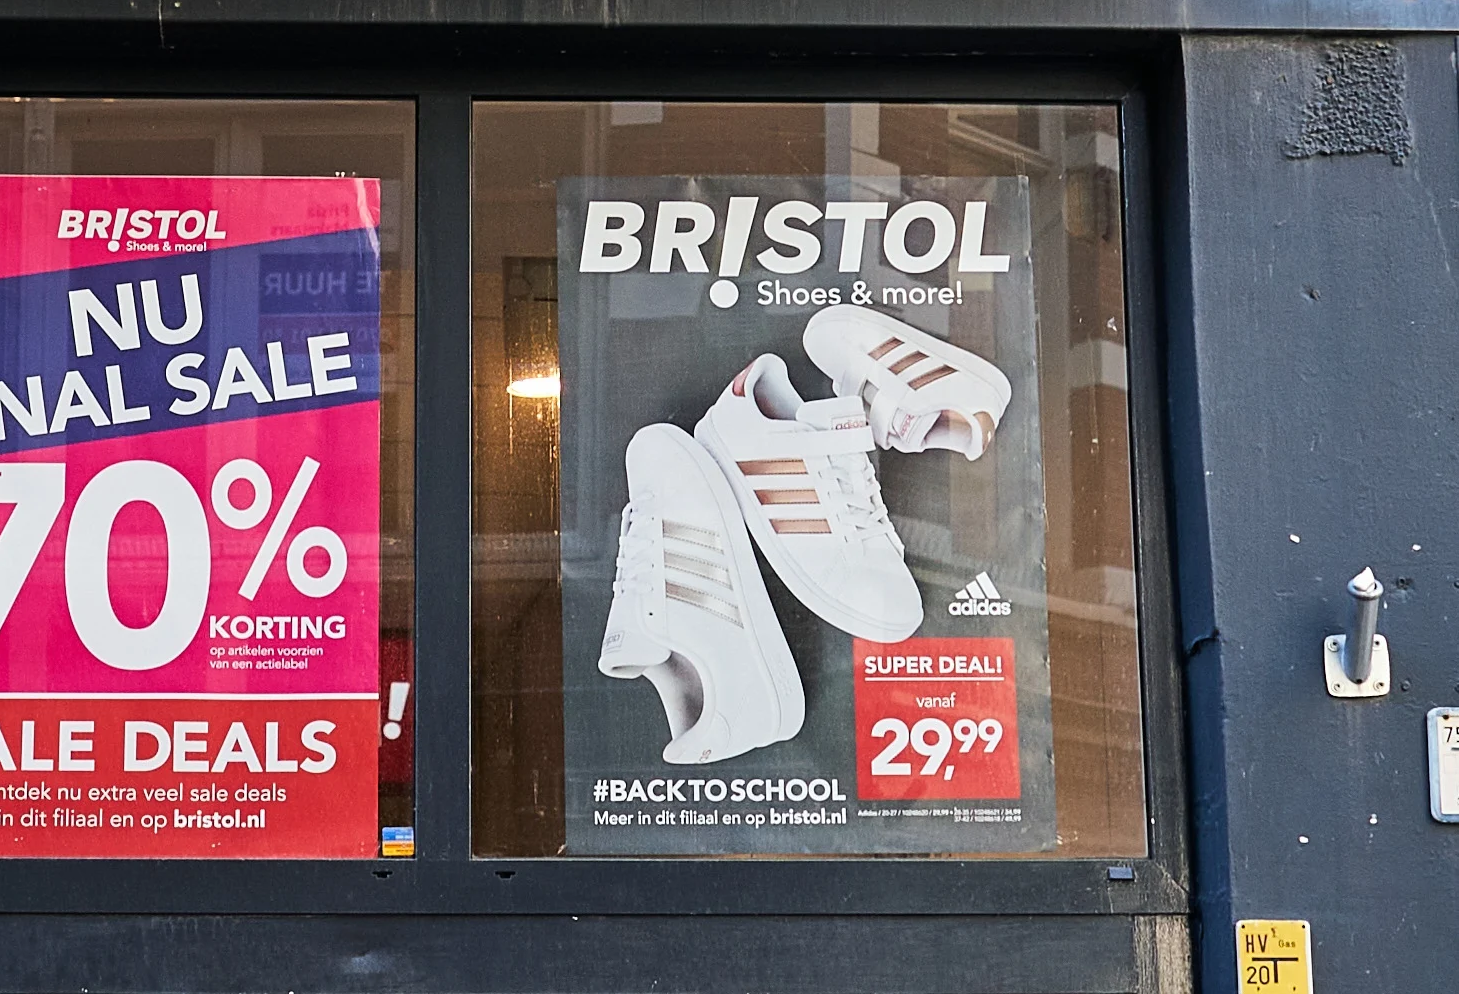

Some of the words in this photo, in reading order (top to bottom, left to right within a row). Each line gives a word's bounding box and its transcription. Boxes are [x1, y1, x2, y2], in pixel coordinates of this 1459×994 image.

[58, 208, 226, 252] BR!STOL
[127, 241, 159, 251] Shoes
[163, 242, 171, 251] &
[175, 242, 206, 252] more!
[580, 197, 1010, 308] BR!STOL
[758, 280, 841, 305] Shoes
[852, 281, 873, 305] &
[883, 281, 962, 304] more!
[69, 274, 205, 357] NU
[165, 332, 358, 415] SALE
[949, 598, 1012, 615] adidas
[210, 616, 345, 639] KORTING
[210, 647, 225, 658] op
[228, 646, 274, 657] artikelen
[277, 646, 323, 657] voorzien
[210, 661, 229, 669] van
[232, 661, 252, 669] een
[256, 658, 307, 669] actielabel
[865, 656, 932, 673] SUPER
[939, 656, 1002, 673] DEAL!
[916, 692, 955, 708] vanaf
[124, 720, 336, 773] DEALS
[872, 718, 1002, 780] 29,99
[58, 788, 81, 800] nu
[89, 786, 136, 801] extra
[144, 783, 183, 801] veel
[190, 783, 228, 801] sale
[235, 783, 286, 801] deals
[21, 808, 46, 827] dit
[53, 808, 102, 827] filiaal
[110, 815, 133, 827] en
[141, 815, 167, 834] op
[174, 809, 265, 828] bristol.nl
[595, 810, 632, 824] Meer
[638, 811, 651, 824] in
[656, 810, 675, 824] dit
[680, 810, 718, 824] filiaal
[723, 814, 740, 824] en
[746, 814, 765, 828] op
[770, 808, 846, 824] bristol.nl
[1246, 935, 1267, 953] HV
[1247, 966, 1269, 985] 20
